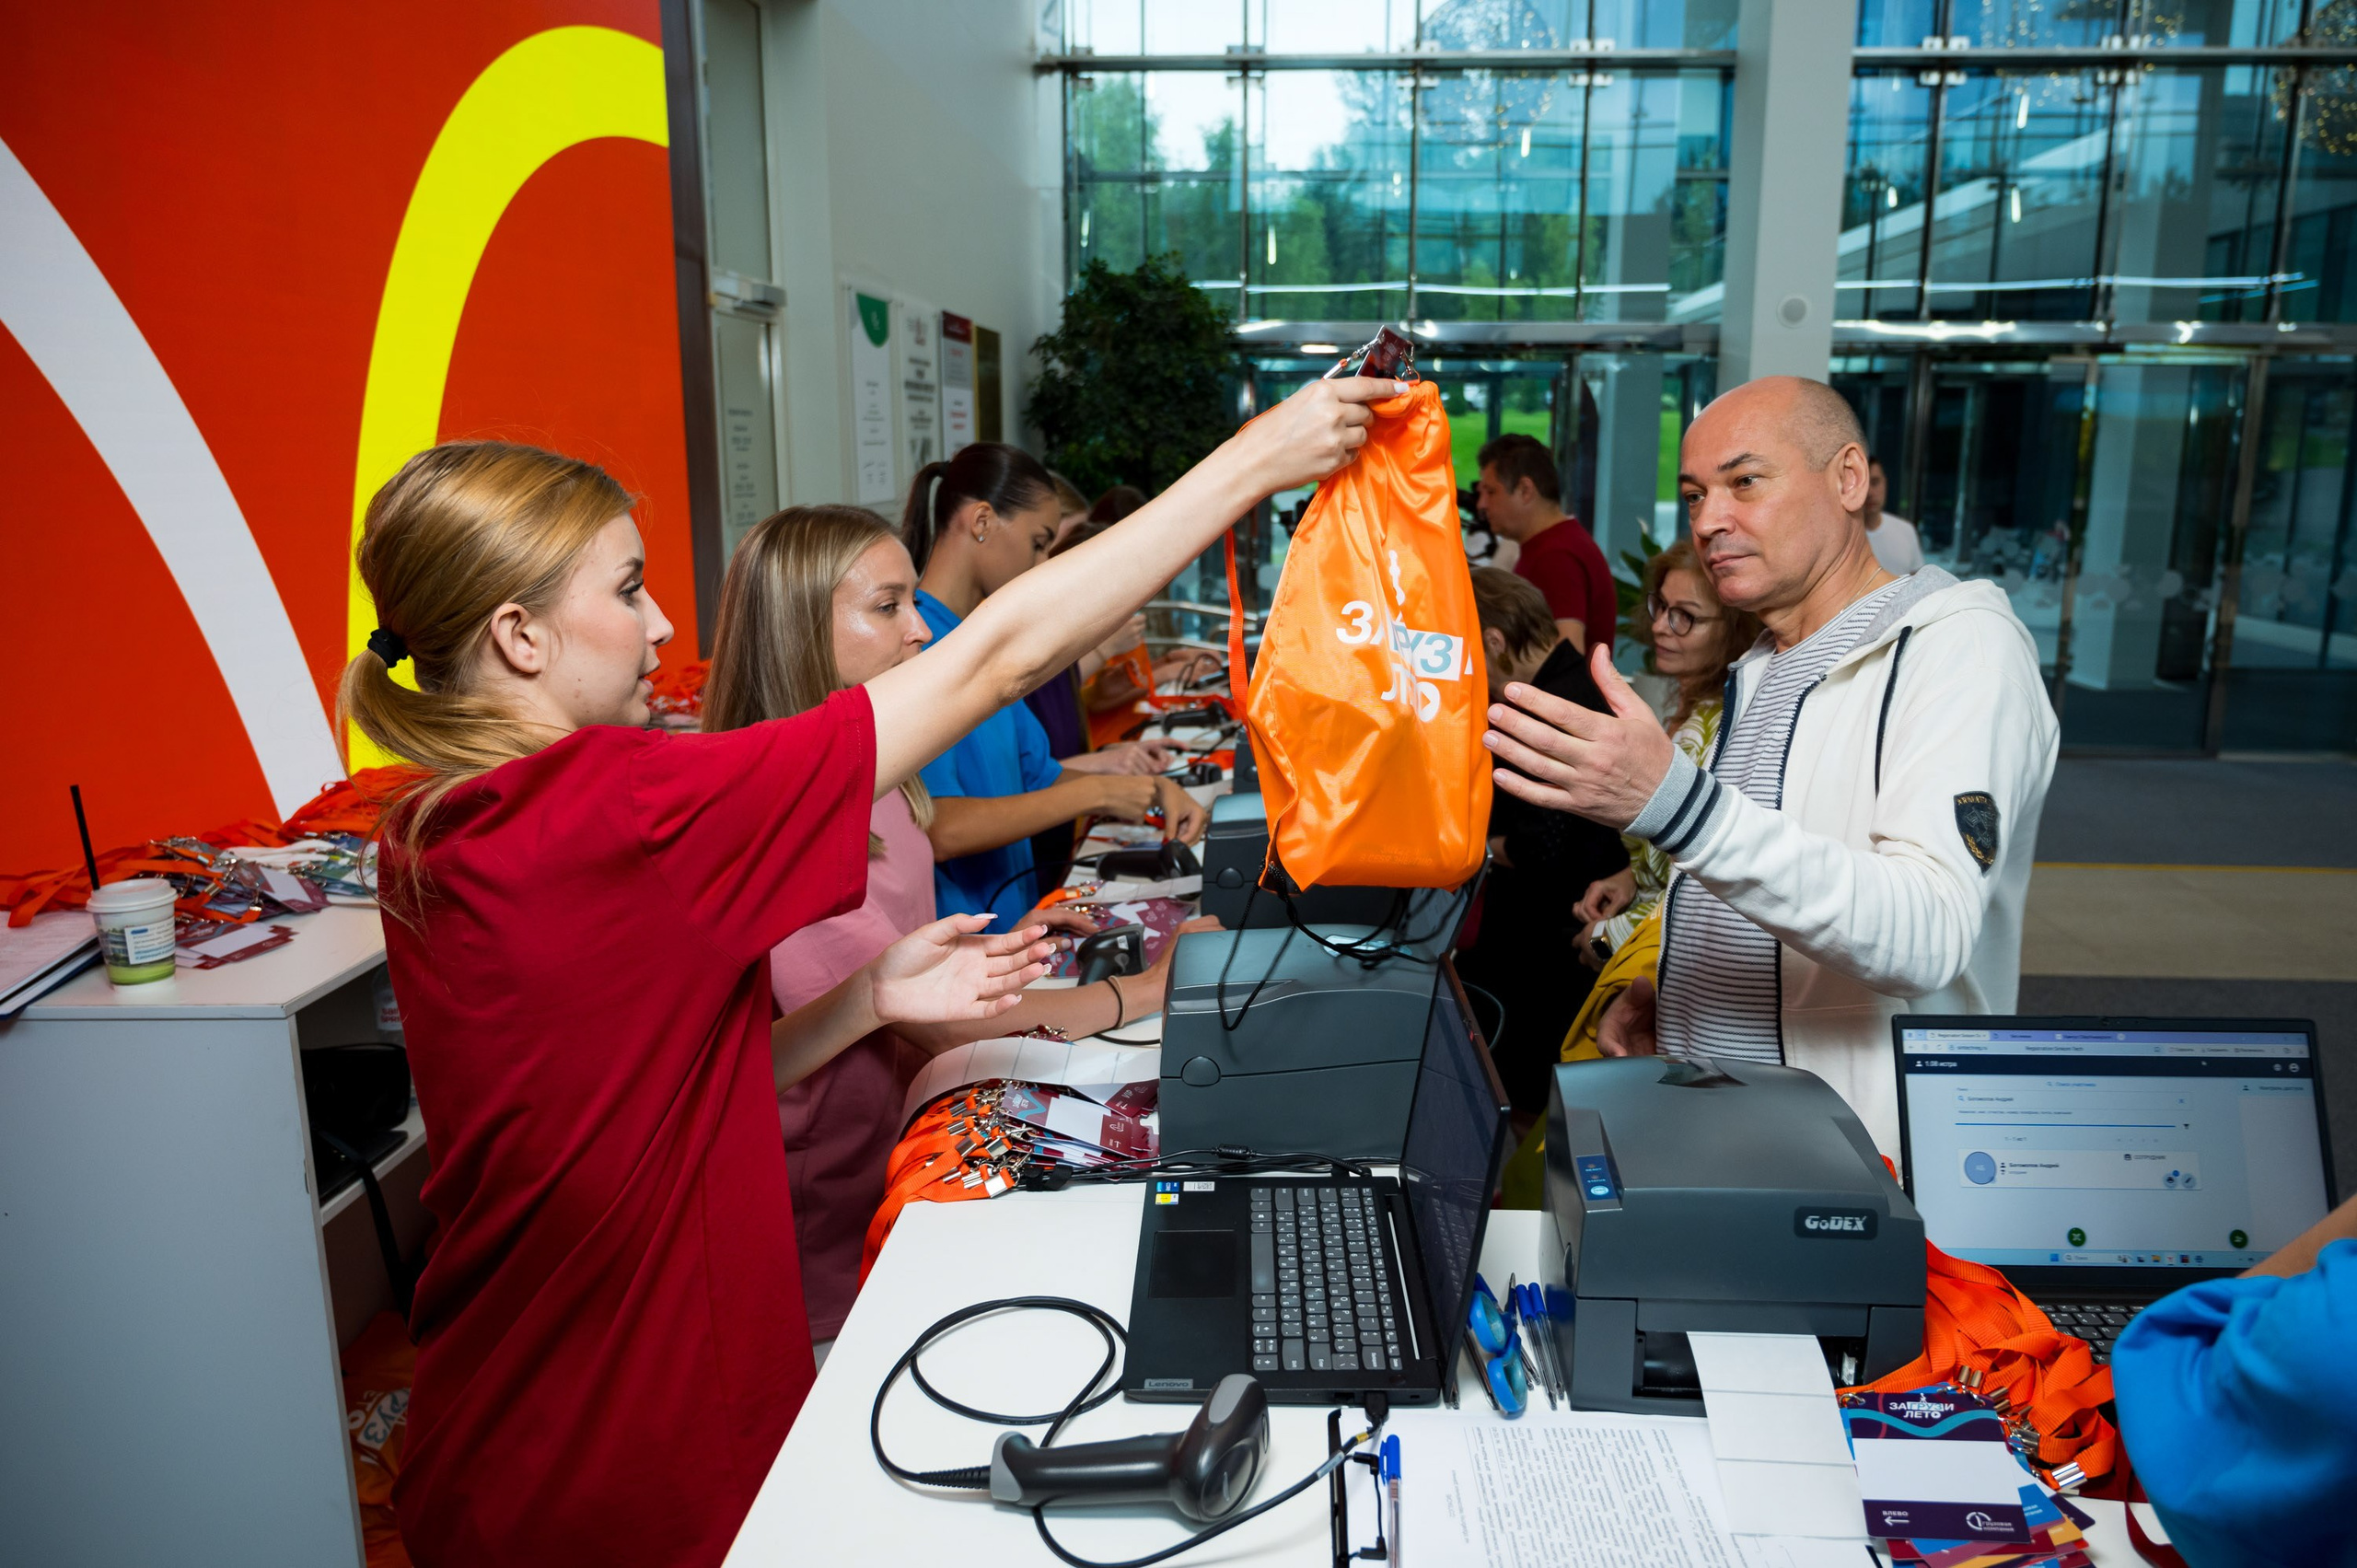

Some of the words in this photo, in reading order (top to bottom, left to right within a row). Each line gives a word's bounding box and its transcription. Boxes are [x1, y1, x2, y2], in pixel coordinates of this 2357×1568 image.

[1805, 1215, 1867, 1231] GoDEX
[1889, 1400, 1955, 1411] ЗАГРУЗИ
[1903, 1411, 1942, 1419] ЛЕТО
